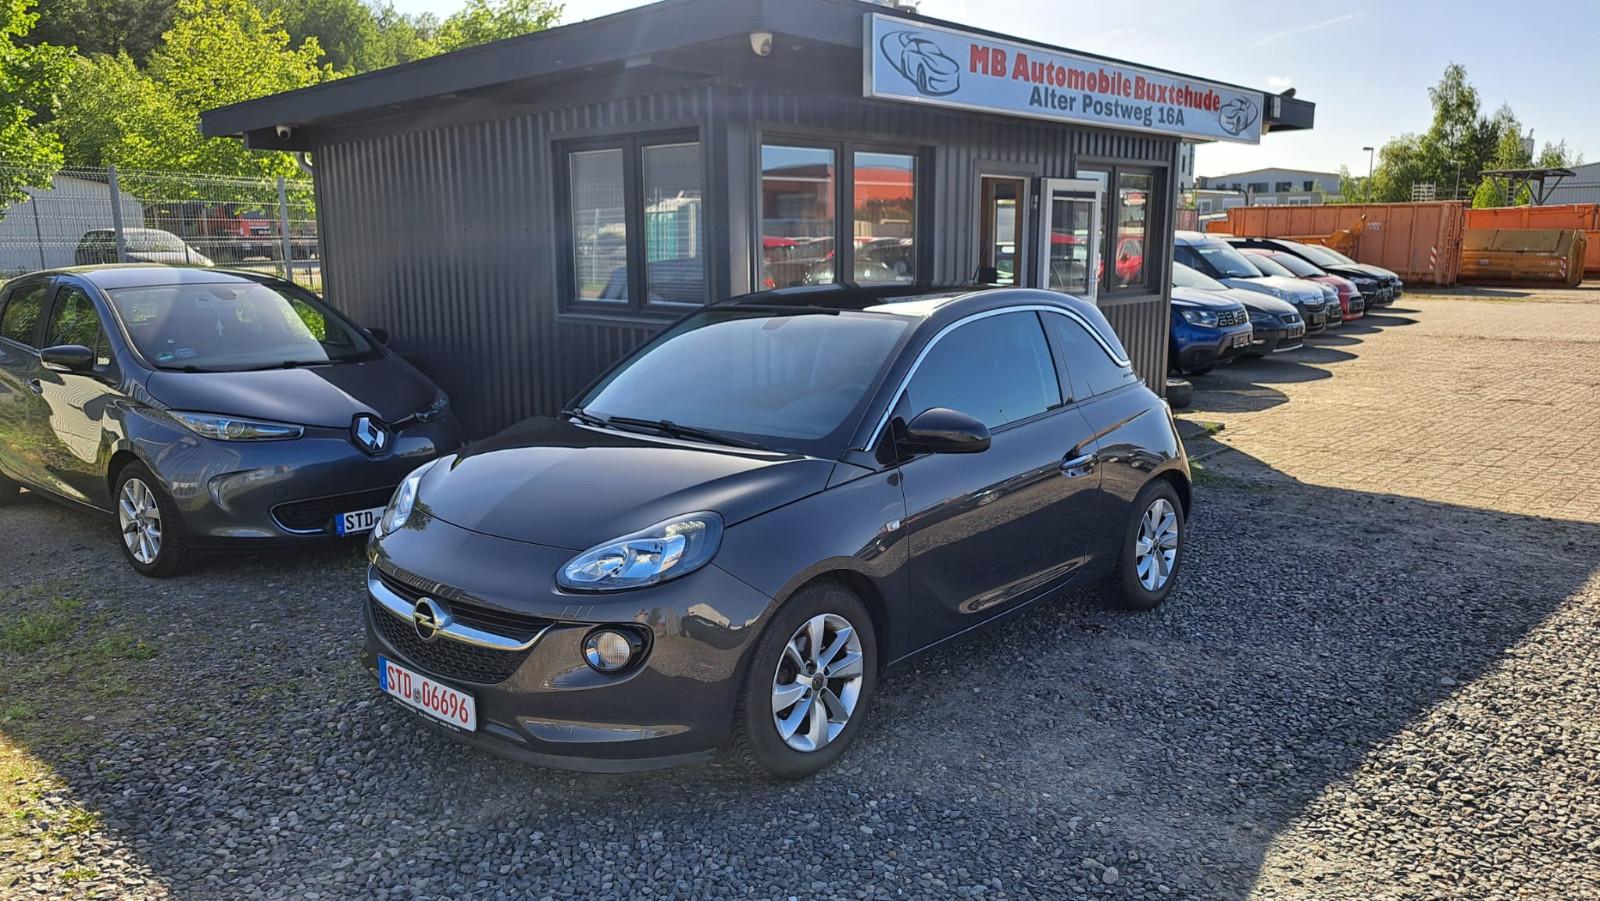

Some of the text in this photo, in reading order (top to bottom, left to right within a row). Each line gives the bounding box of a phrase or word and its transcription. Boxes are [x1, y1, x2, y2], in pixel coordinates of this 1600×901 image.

[969, 44, 1007, 77] MB
[1029, 86, 1185, 127] Alter Postweg 16A
[345, 511, 373, 530] STD
[388, 665, 412, 699] STD
[422, 681, 469, 724] 06696
